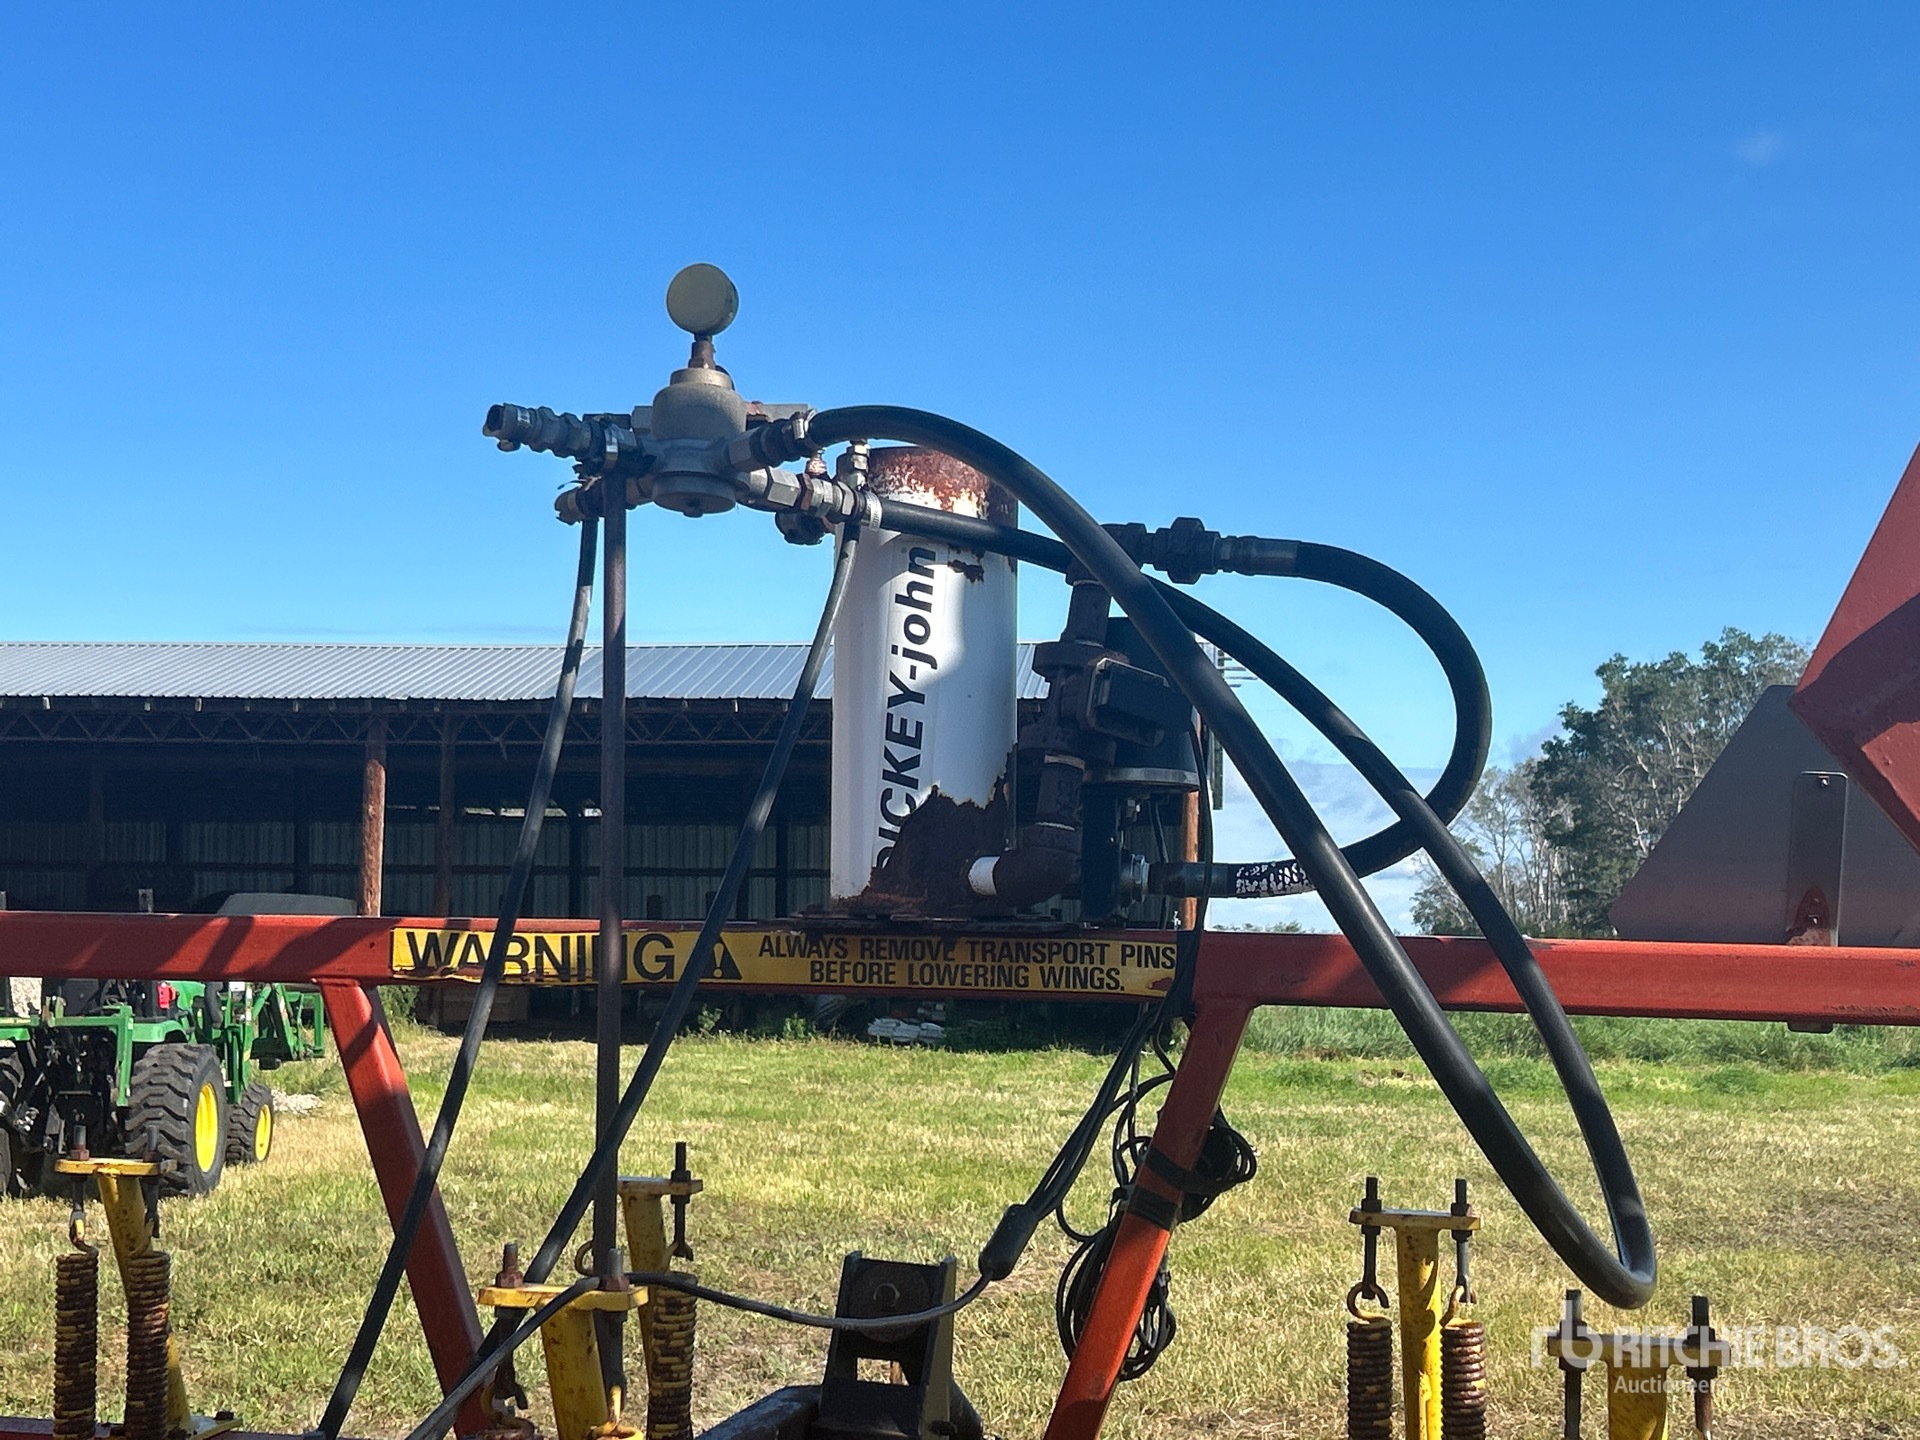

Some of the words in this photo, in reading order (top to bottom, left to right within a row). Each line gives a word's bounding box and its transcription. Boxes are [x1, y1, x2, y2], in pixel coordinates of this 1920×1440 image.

[759, 935, 848, 959] ALWAYS
[860, 937, 957, 961] REMOVE
[966, 940, 1110, 965] TRANSPORT
[1121, 944, 1176, 969] PINS
[810, 961, 897, 983] BEFORE
[908, 963, 1029, 988] LOWERING
[1039, 966, 1125, 991] WINGS.
